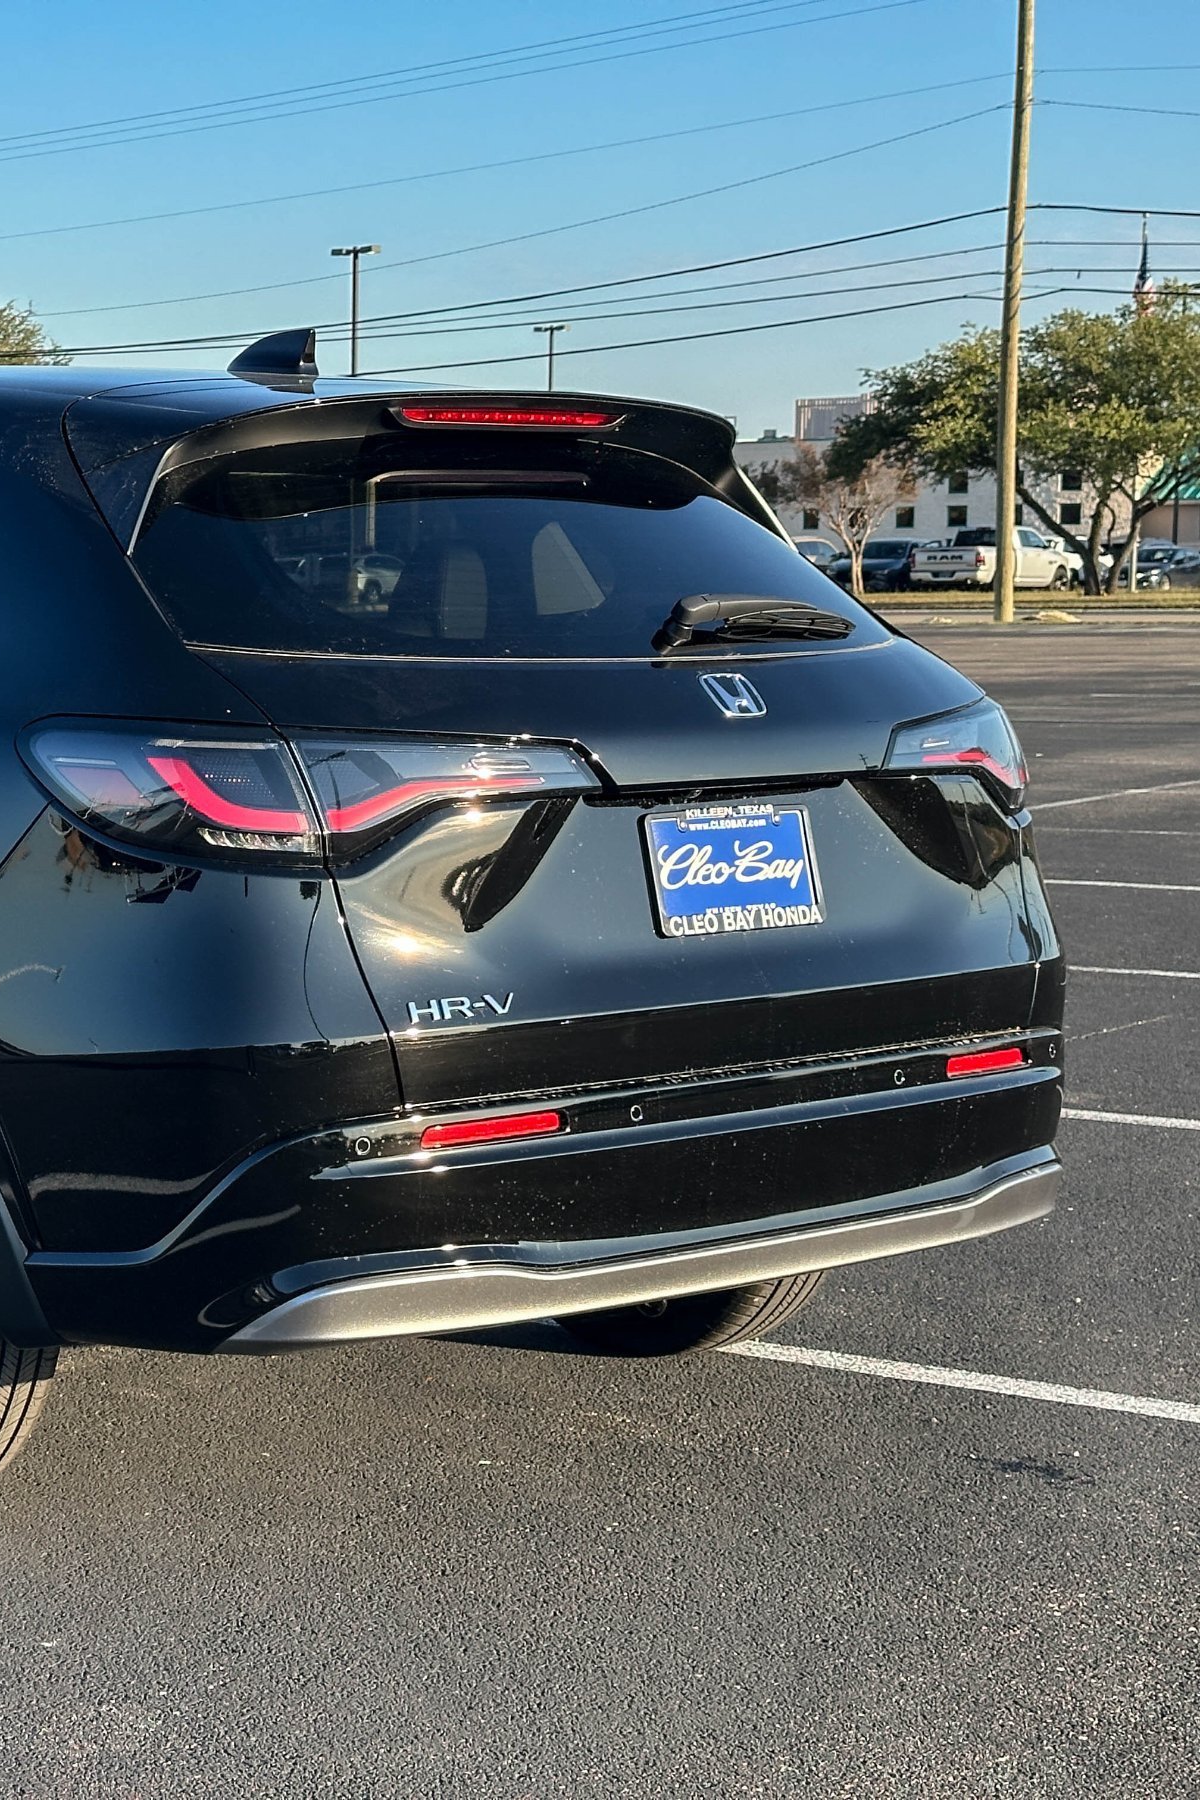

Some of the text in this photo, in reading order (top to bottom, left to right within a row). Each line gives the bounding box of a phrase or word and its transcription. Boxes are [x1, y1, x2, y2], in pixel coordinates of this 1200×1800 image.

[738, 804, 773, 815] TEXAS
[657, 840, 804, 890] Cleo Bay
[669, 913, 719, 937] CLEO
[723, 908, 759, 931] BAY
[761, 904, 823, 927] HONDA
[407, 992, 514, 1024] HR-V
